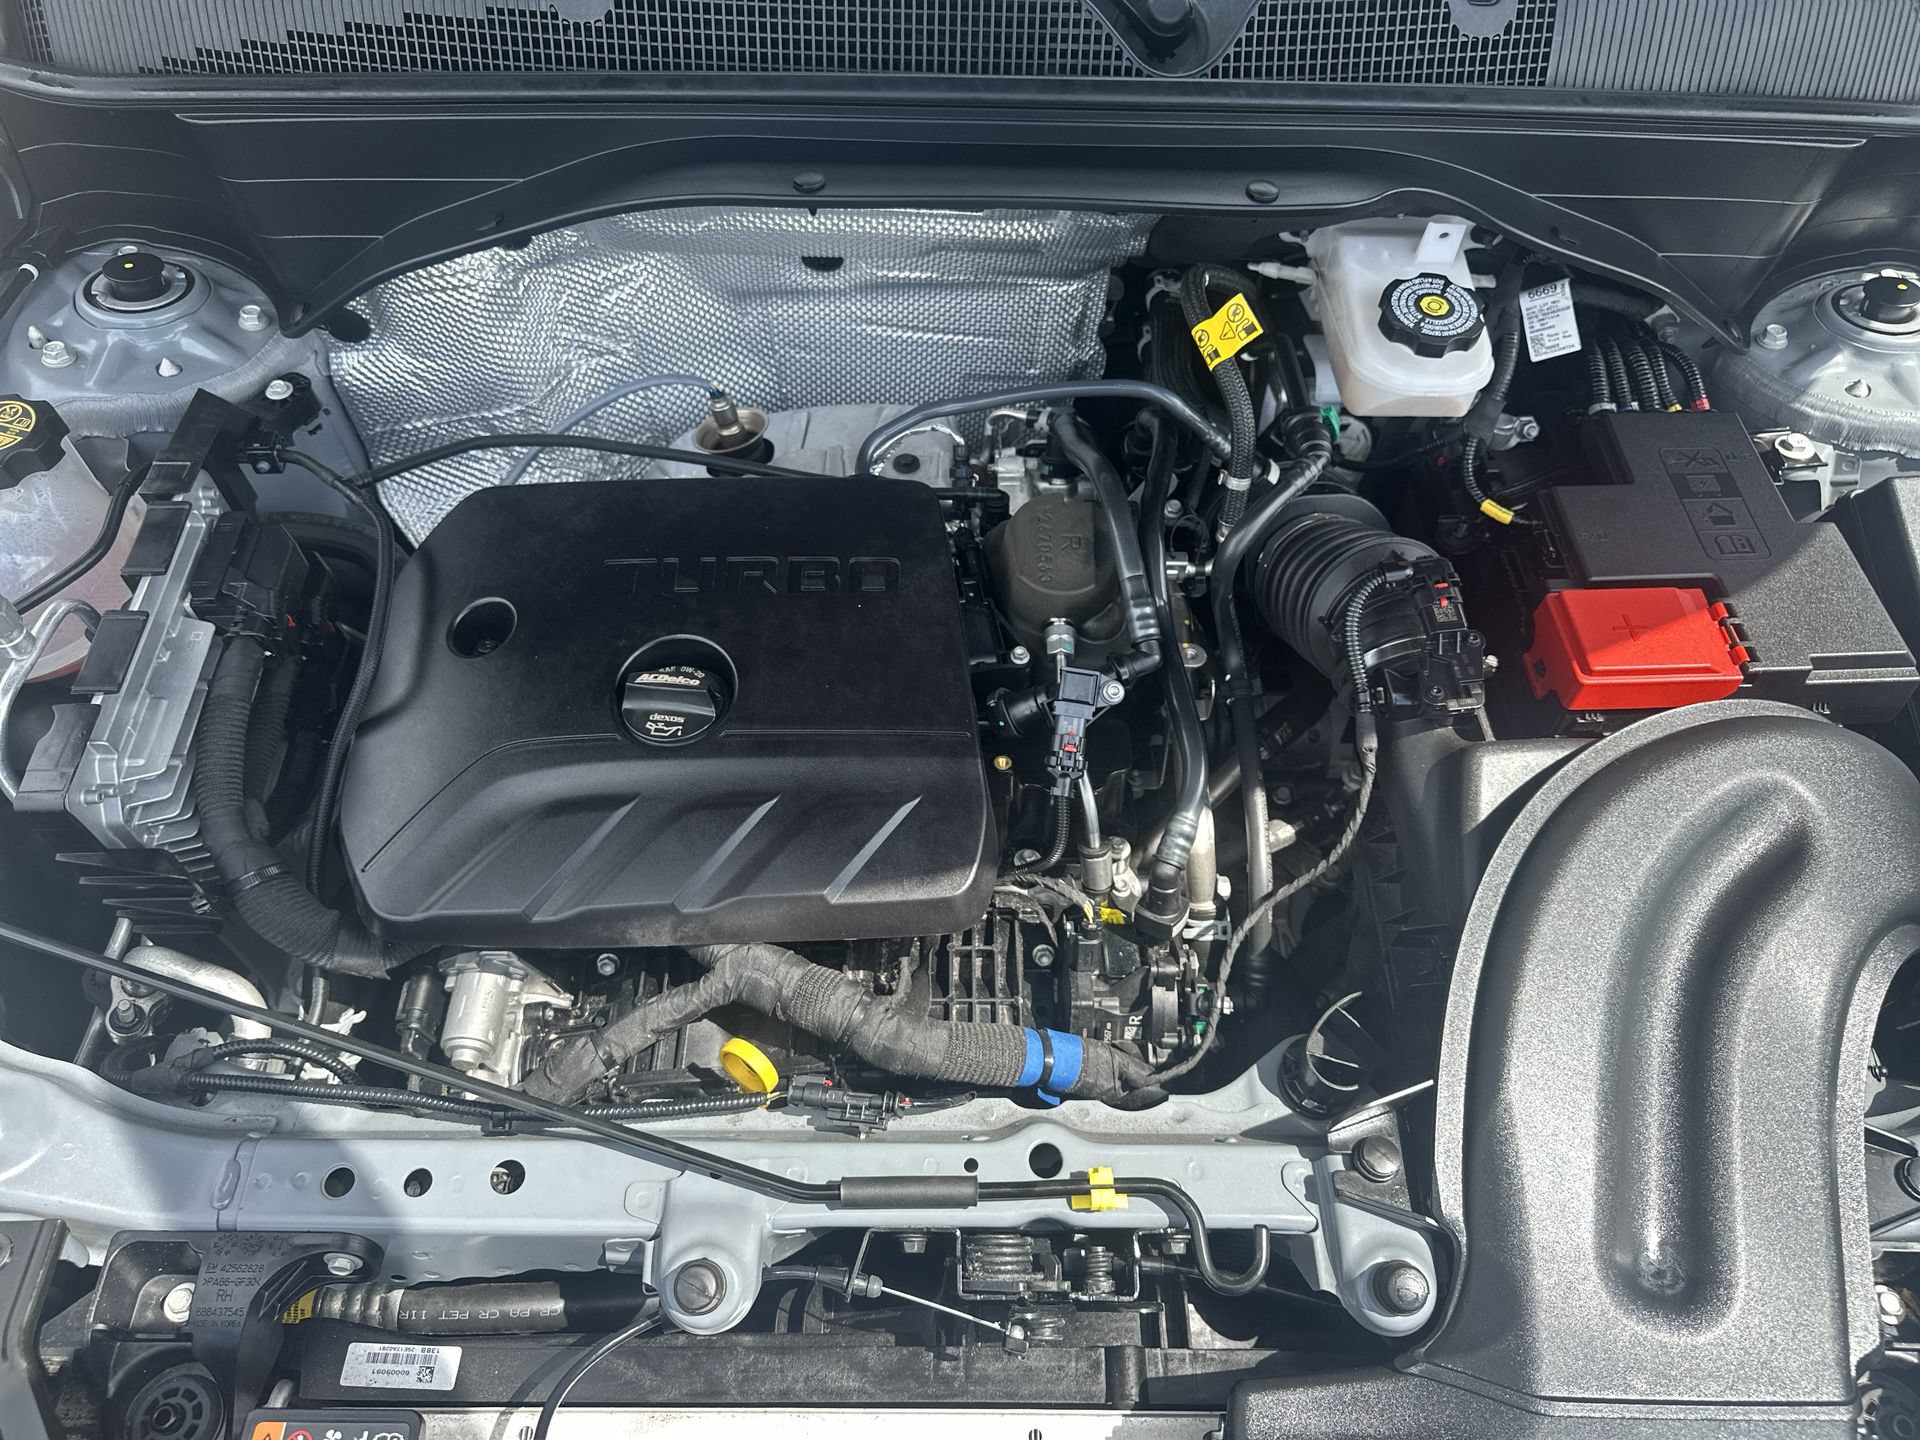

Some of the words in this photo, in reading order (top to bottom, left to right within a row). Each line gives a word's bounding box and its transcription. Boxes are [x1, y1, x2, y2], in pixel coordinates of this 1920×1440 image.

[1528, 284, 1557, 299] 6669
[1060, 534, 1082, 552] R
[604, 556, 901, 594] TURBO
[680, 666, 705, 678] 0W-20
[634, 673, 701, 686] ACDelco
[649, 713, 686, 723] dexos
[216, 1289, 234, 1302] RH
[438, 1309, 468, 1319] PET
[478, 1308, 499, 1318] CR
[509, 1308, 530, 1316] PA
